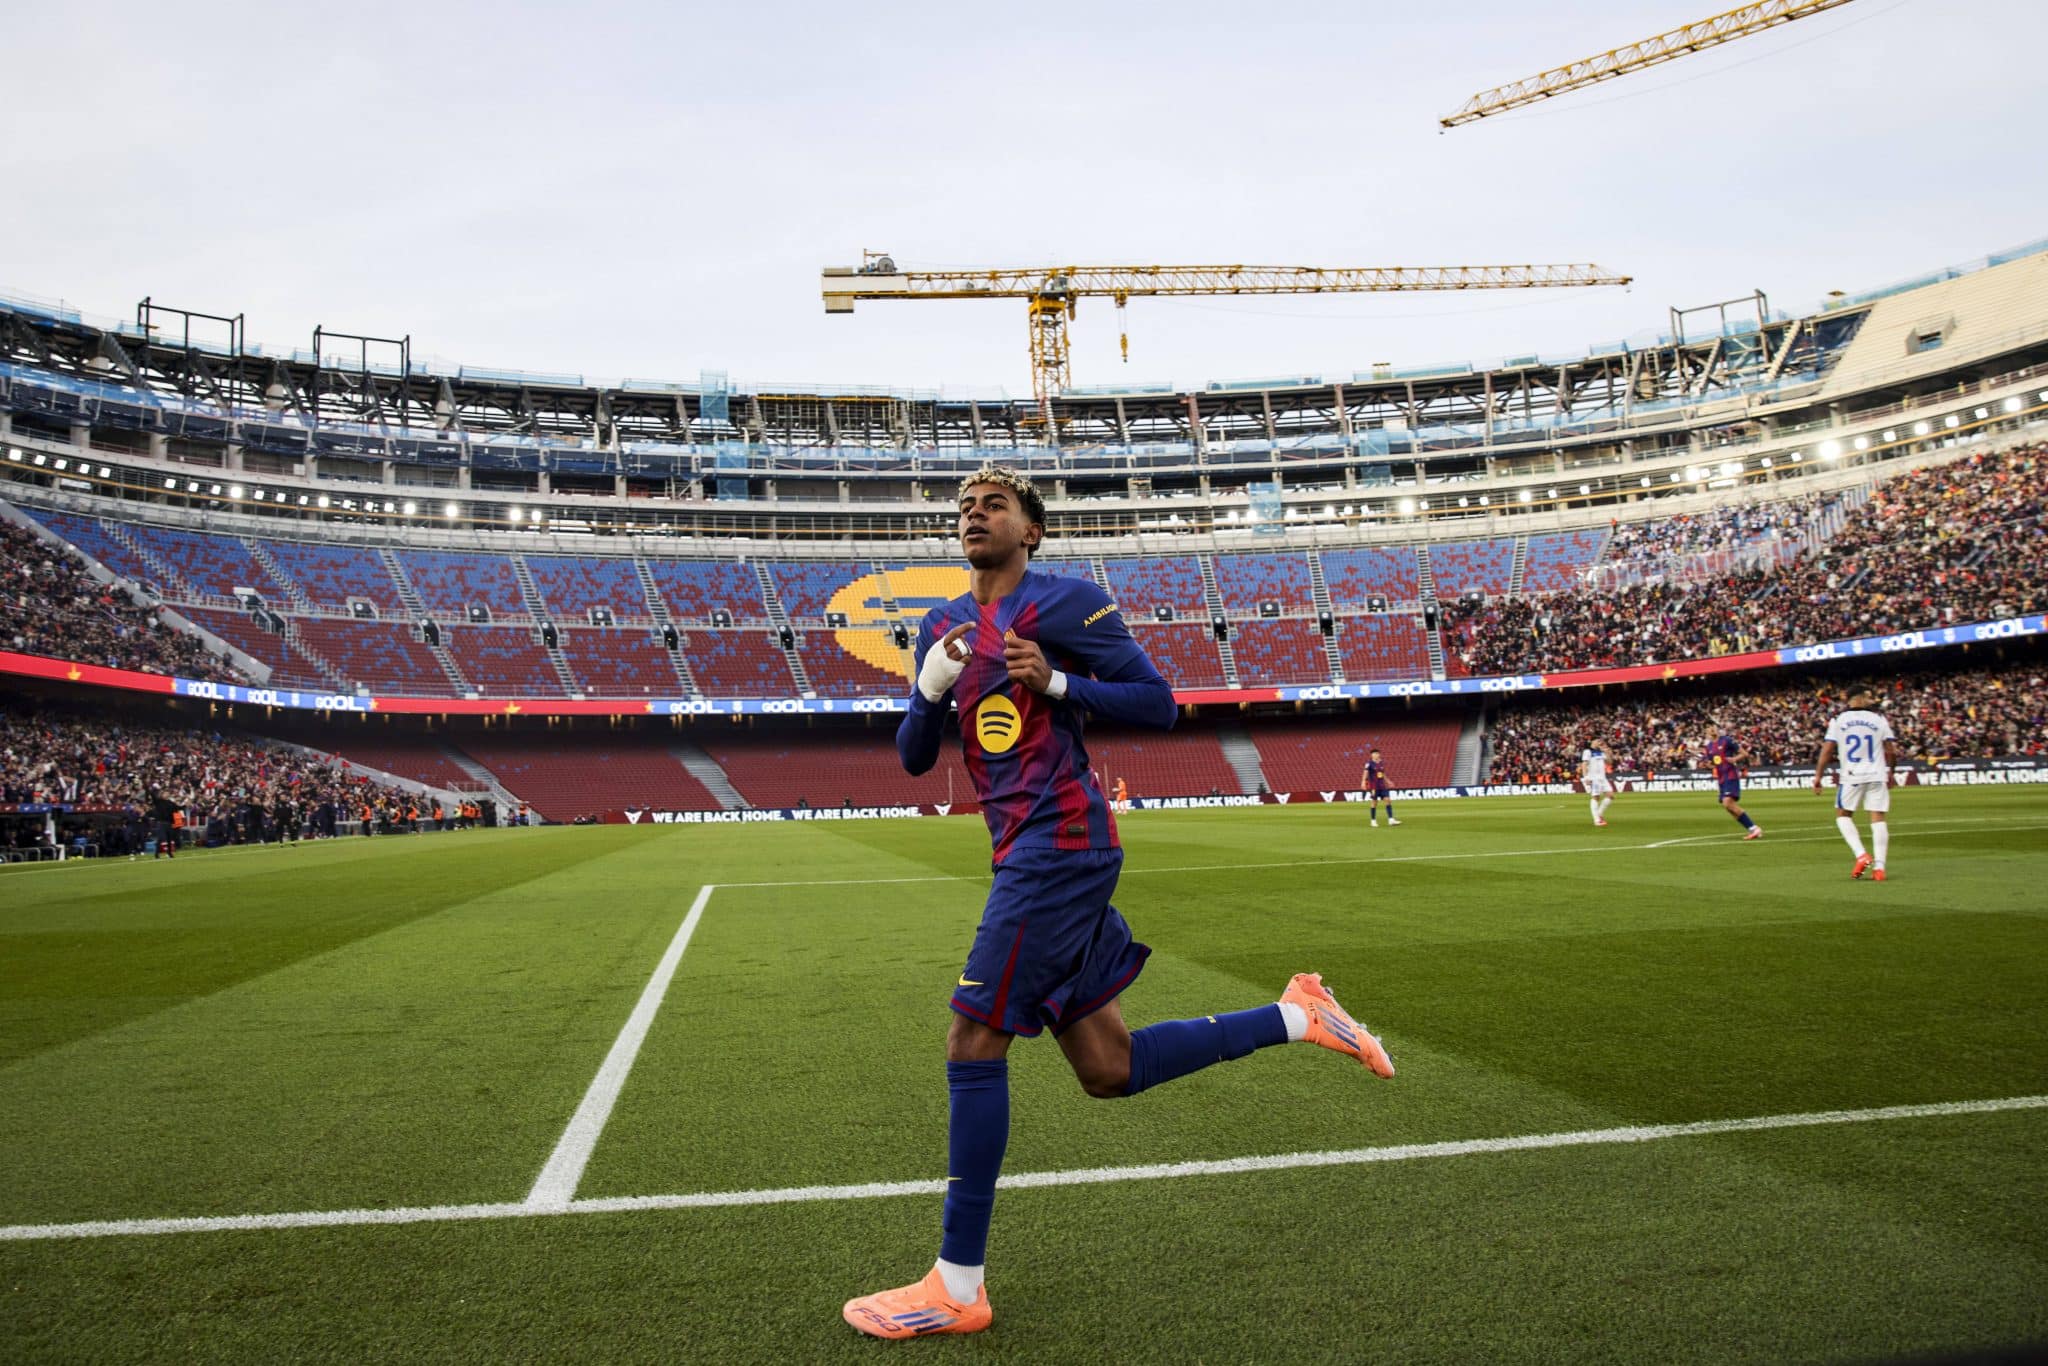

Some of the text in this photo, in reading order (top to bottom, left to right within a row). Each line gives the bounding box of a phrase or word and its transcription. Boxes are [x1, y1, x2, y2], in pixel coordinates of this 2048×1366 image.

[1845, 734, 1874, 763] 21
[1917, 771, 1938, 785] WE
[1940, 770, 1967, 784] ARE
[1968, 770, 2007, 784] BACK
[1632, 781, 1647, 792] WE
[1693, 779, 1719, 791] HOM
[1344, 791, 1363, 801] WE
[1389, 789, 1422, 800] BACK
[1141, 798, 1161, 809] WE
[1163, 798, 1188, 808] ARE
[1190, 797, 1223, 808] BACK
[652, 810, 785, 823] WE ARE BACK HOME.
[792, 807, 922, 820] WE ARE BACK HOME.
